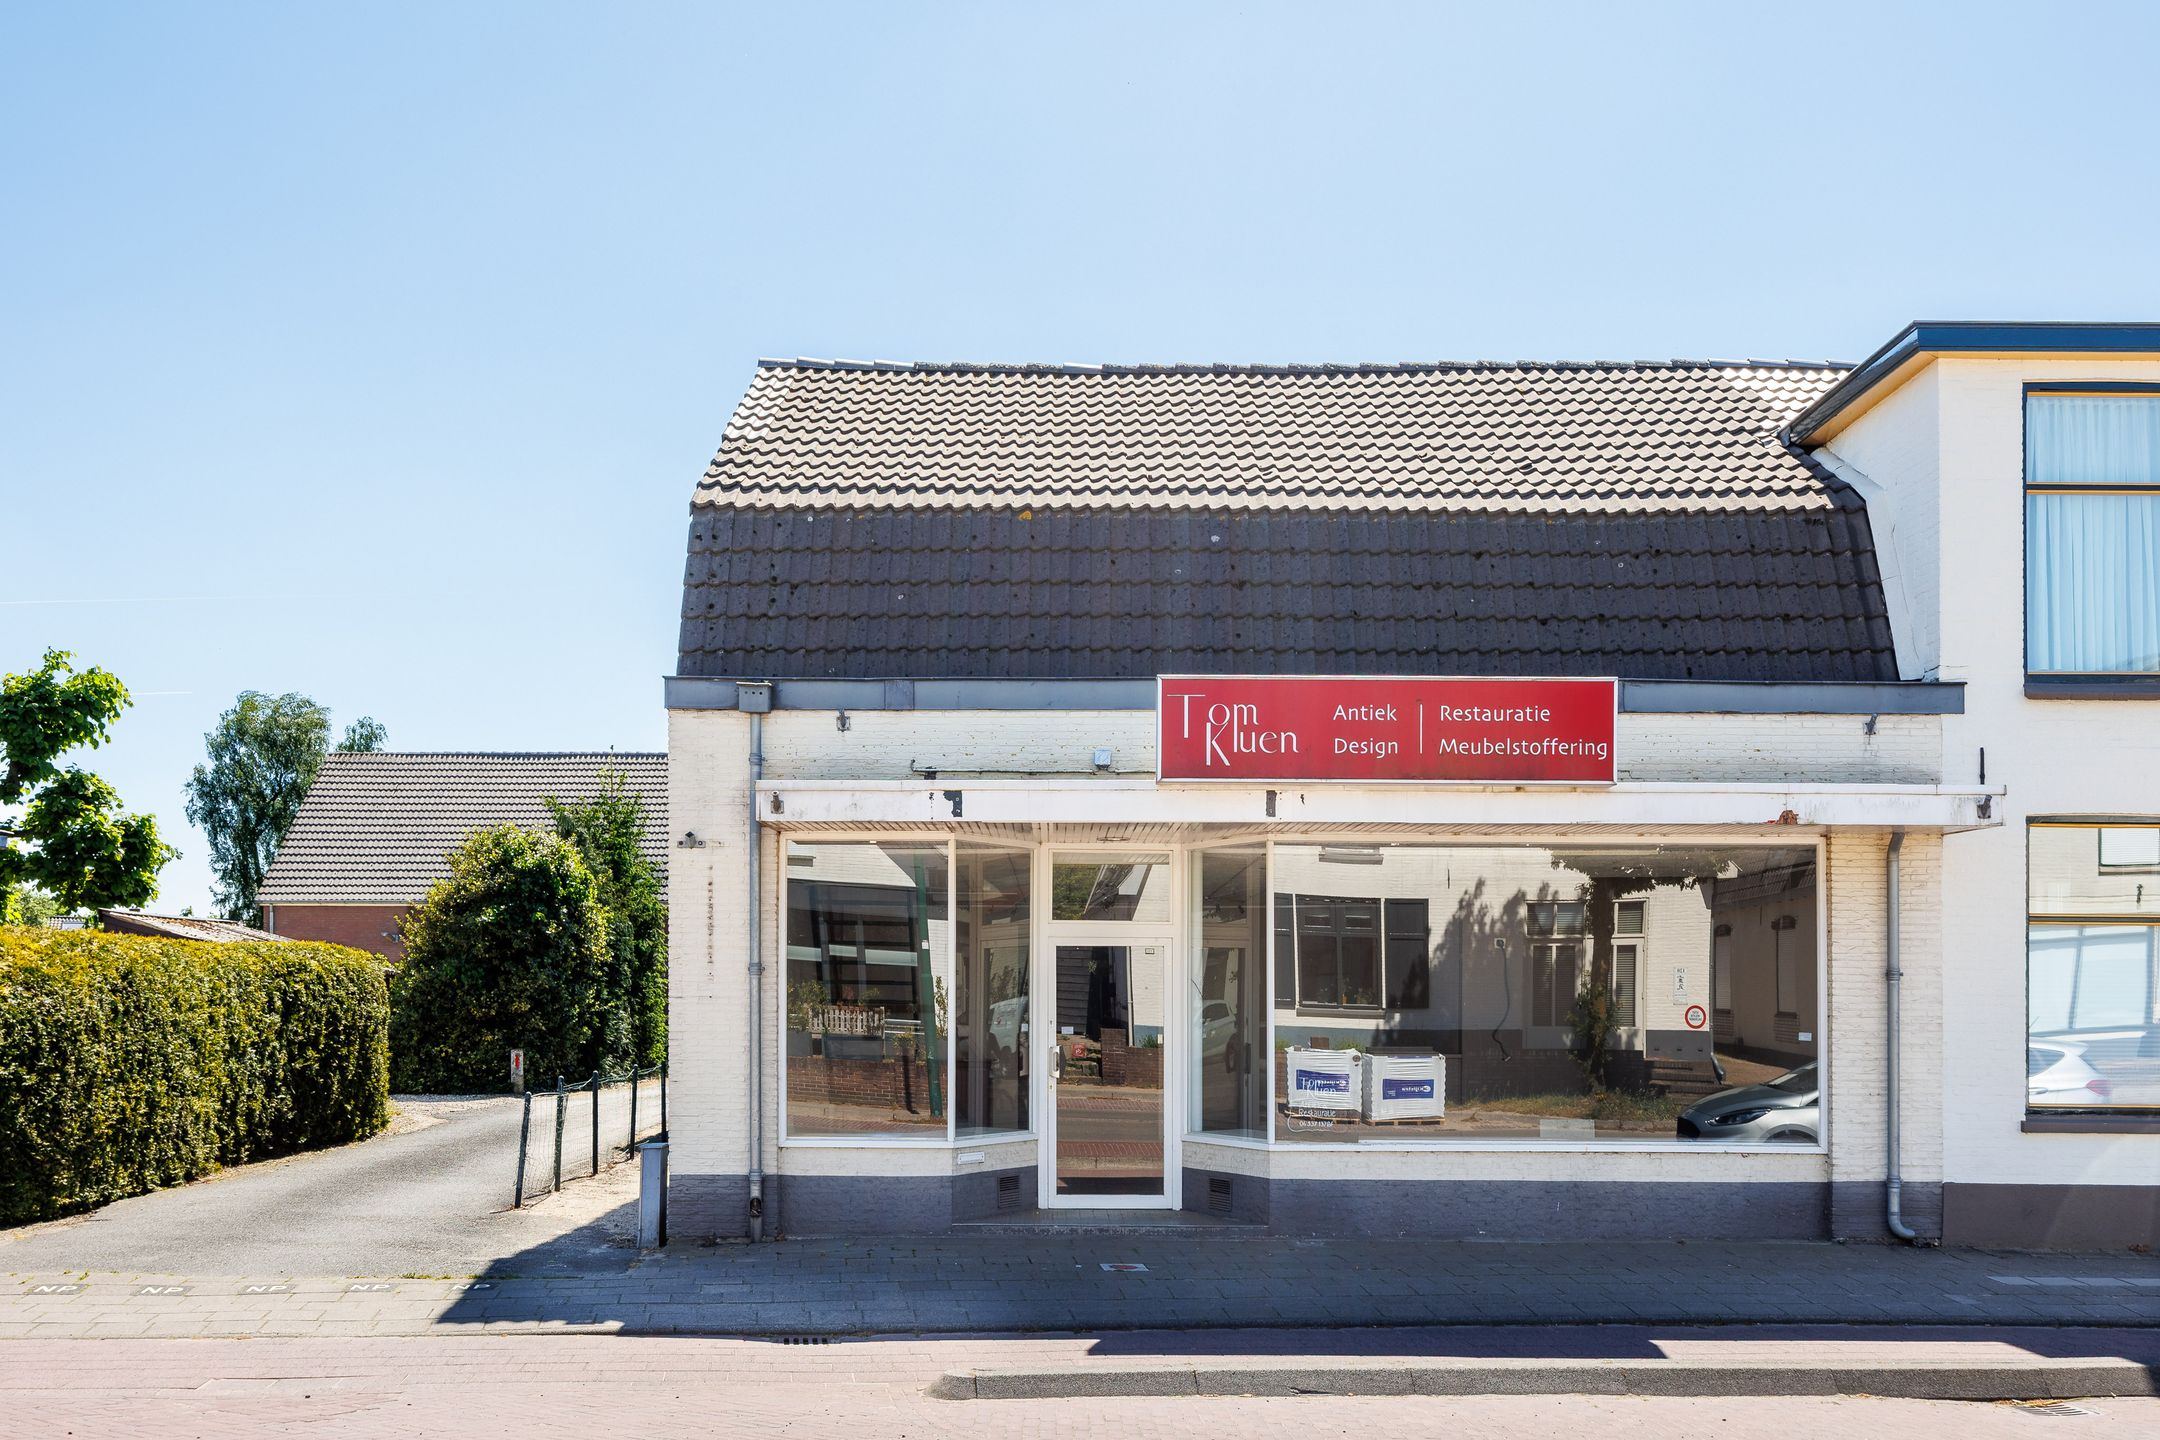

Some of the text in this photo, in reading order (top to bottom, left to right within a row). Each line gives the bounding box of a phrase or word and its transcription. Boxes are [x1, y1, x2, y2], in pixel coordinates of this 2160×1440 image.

[1167, 694, 1260, 739] Tom
[1332, 703, 1398, 722] Antiek
[1439, 704, 1551, 722] Restauratie
[1205, 721, 1300, 767] Kluen
[1333, 737, 1399, 759] Design
[1438, 736, 1608, 761] Meubelstoffering
[33, 1285, 79, 1293] NP
[140, 1286, 185, 1294] NP
[245, 1284, 289, 1293] NP
[349, 1283, 392, 1291] NP
